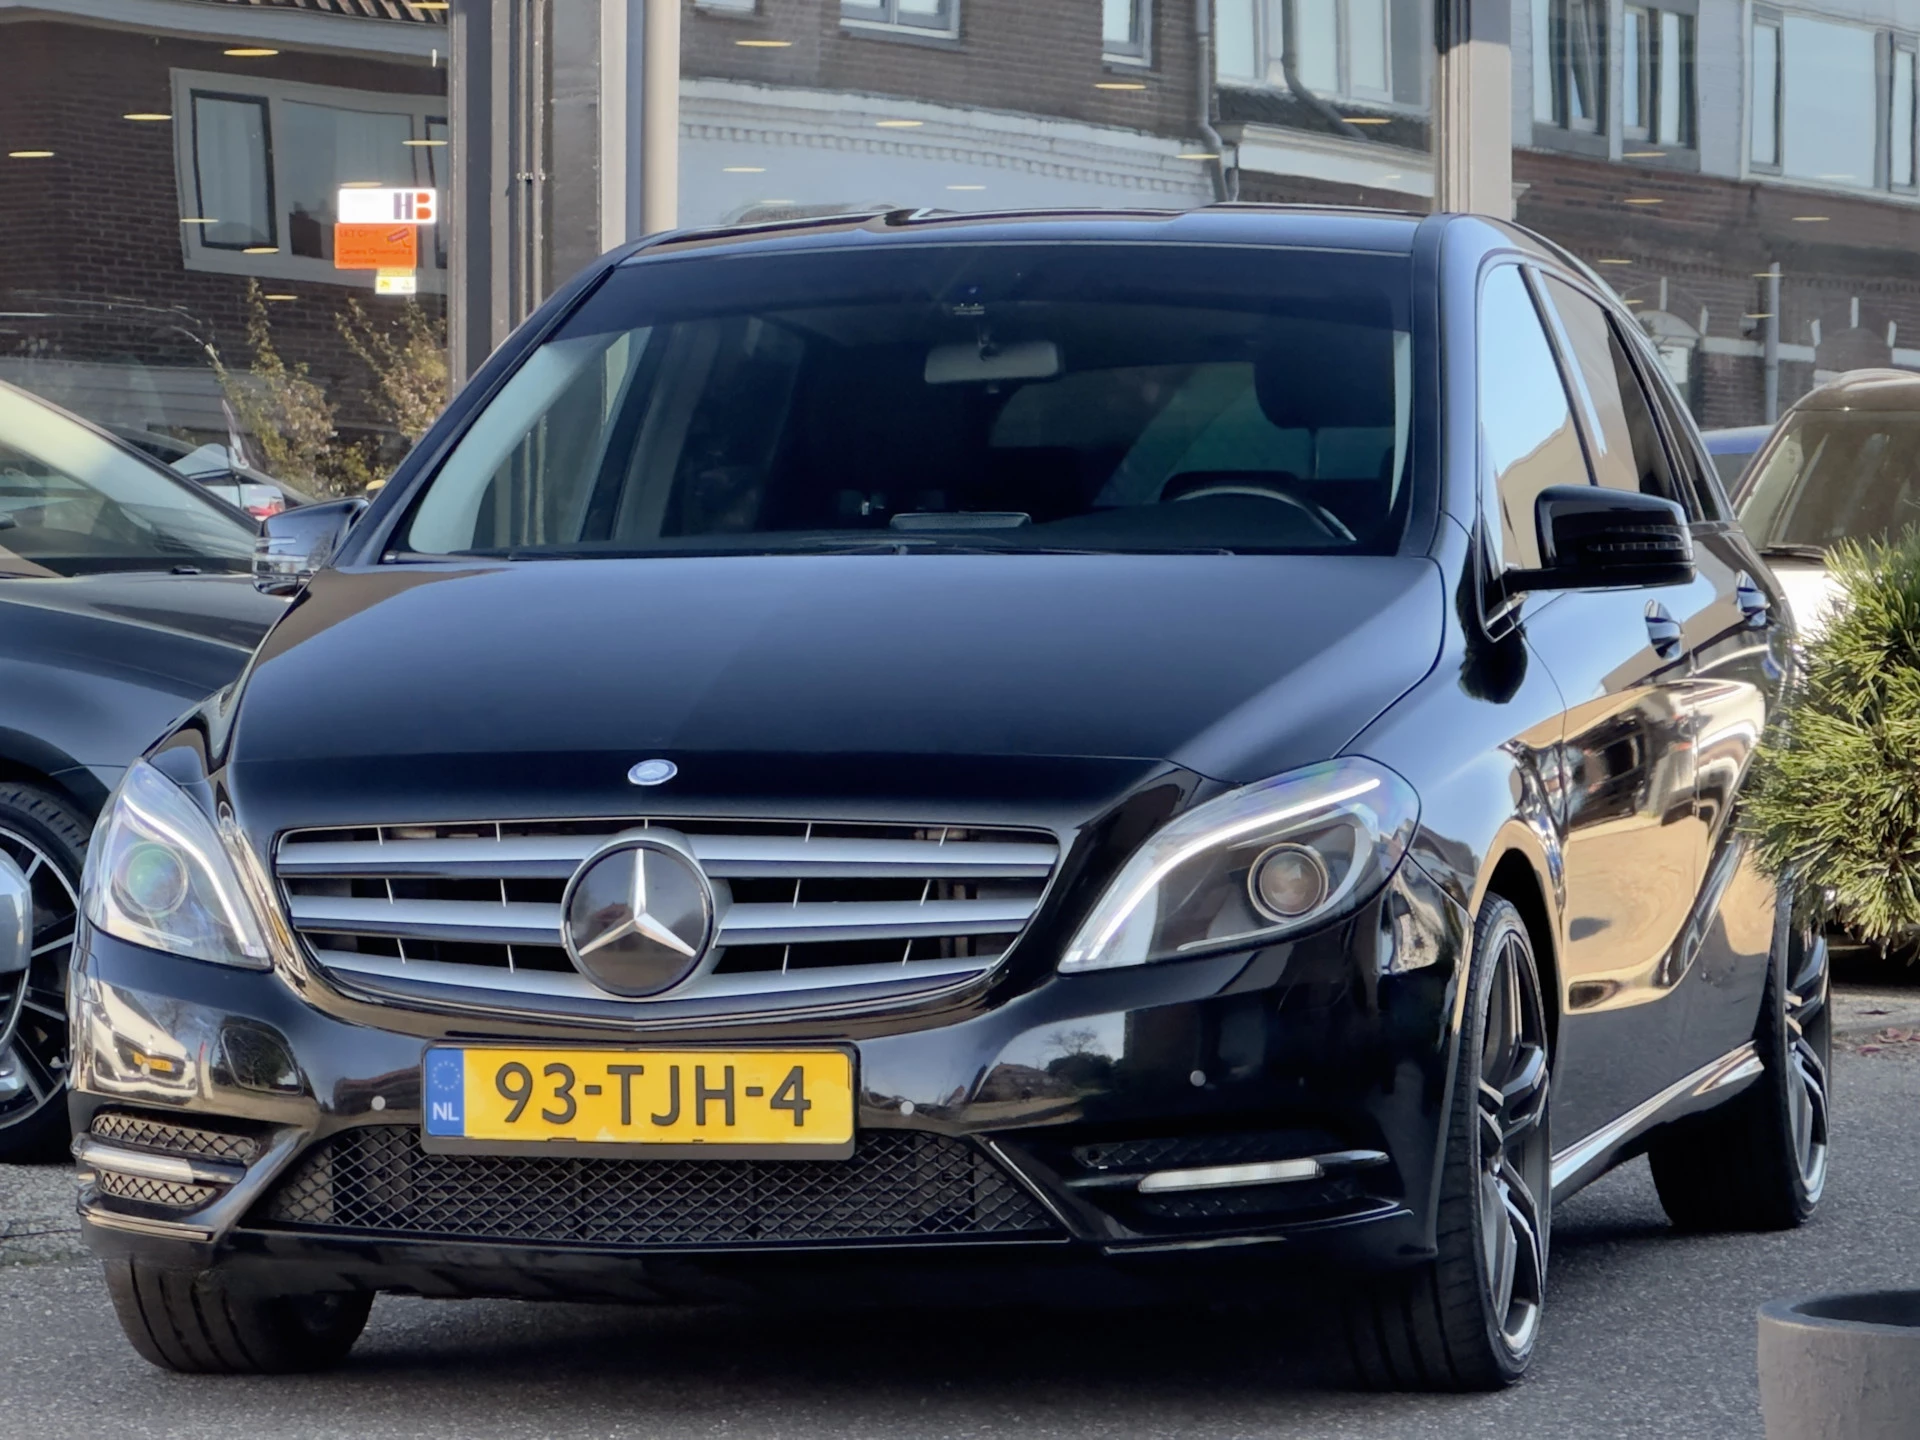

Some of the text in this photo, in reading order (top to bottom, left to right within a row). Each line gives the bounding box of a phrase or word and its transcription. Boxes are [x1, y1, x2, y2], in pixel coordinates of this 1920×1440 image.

[393, 192, 432, 220] HB
[495, 1062, 811, 1126] 93-TJH-4
[432, 1102, 459, 1121] NL
